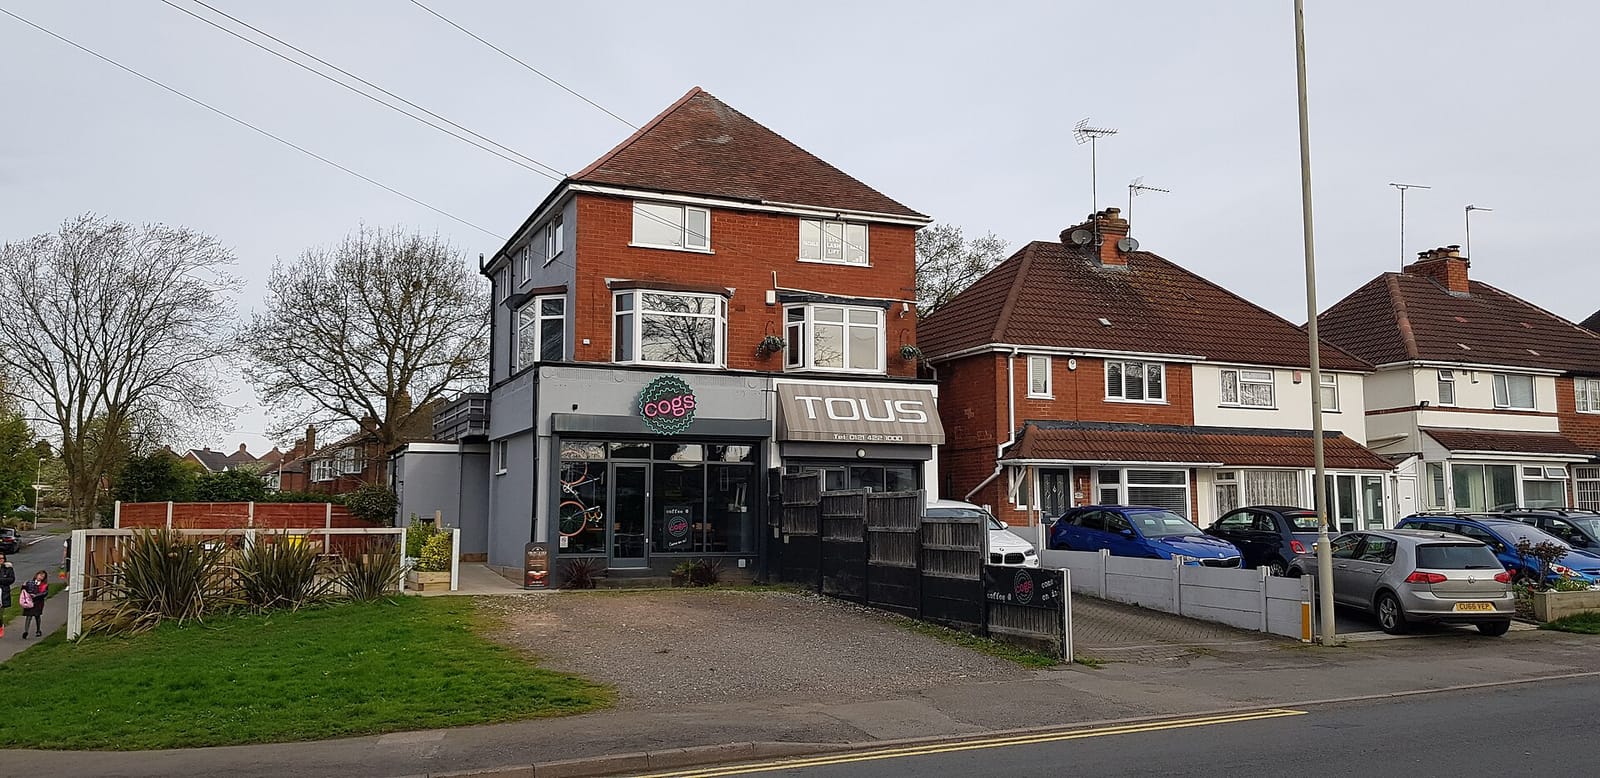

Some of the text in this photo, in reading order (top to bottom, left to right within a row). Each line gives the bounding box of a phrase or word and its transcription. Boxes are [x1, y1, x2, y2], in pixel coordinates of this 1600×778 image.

[644, 395, 695, 417] cogs
[794, 396, 928, 423] TOUS
[986, 591, 1006, 601] coffee
[1014, 580, 1033, 594] cogs
